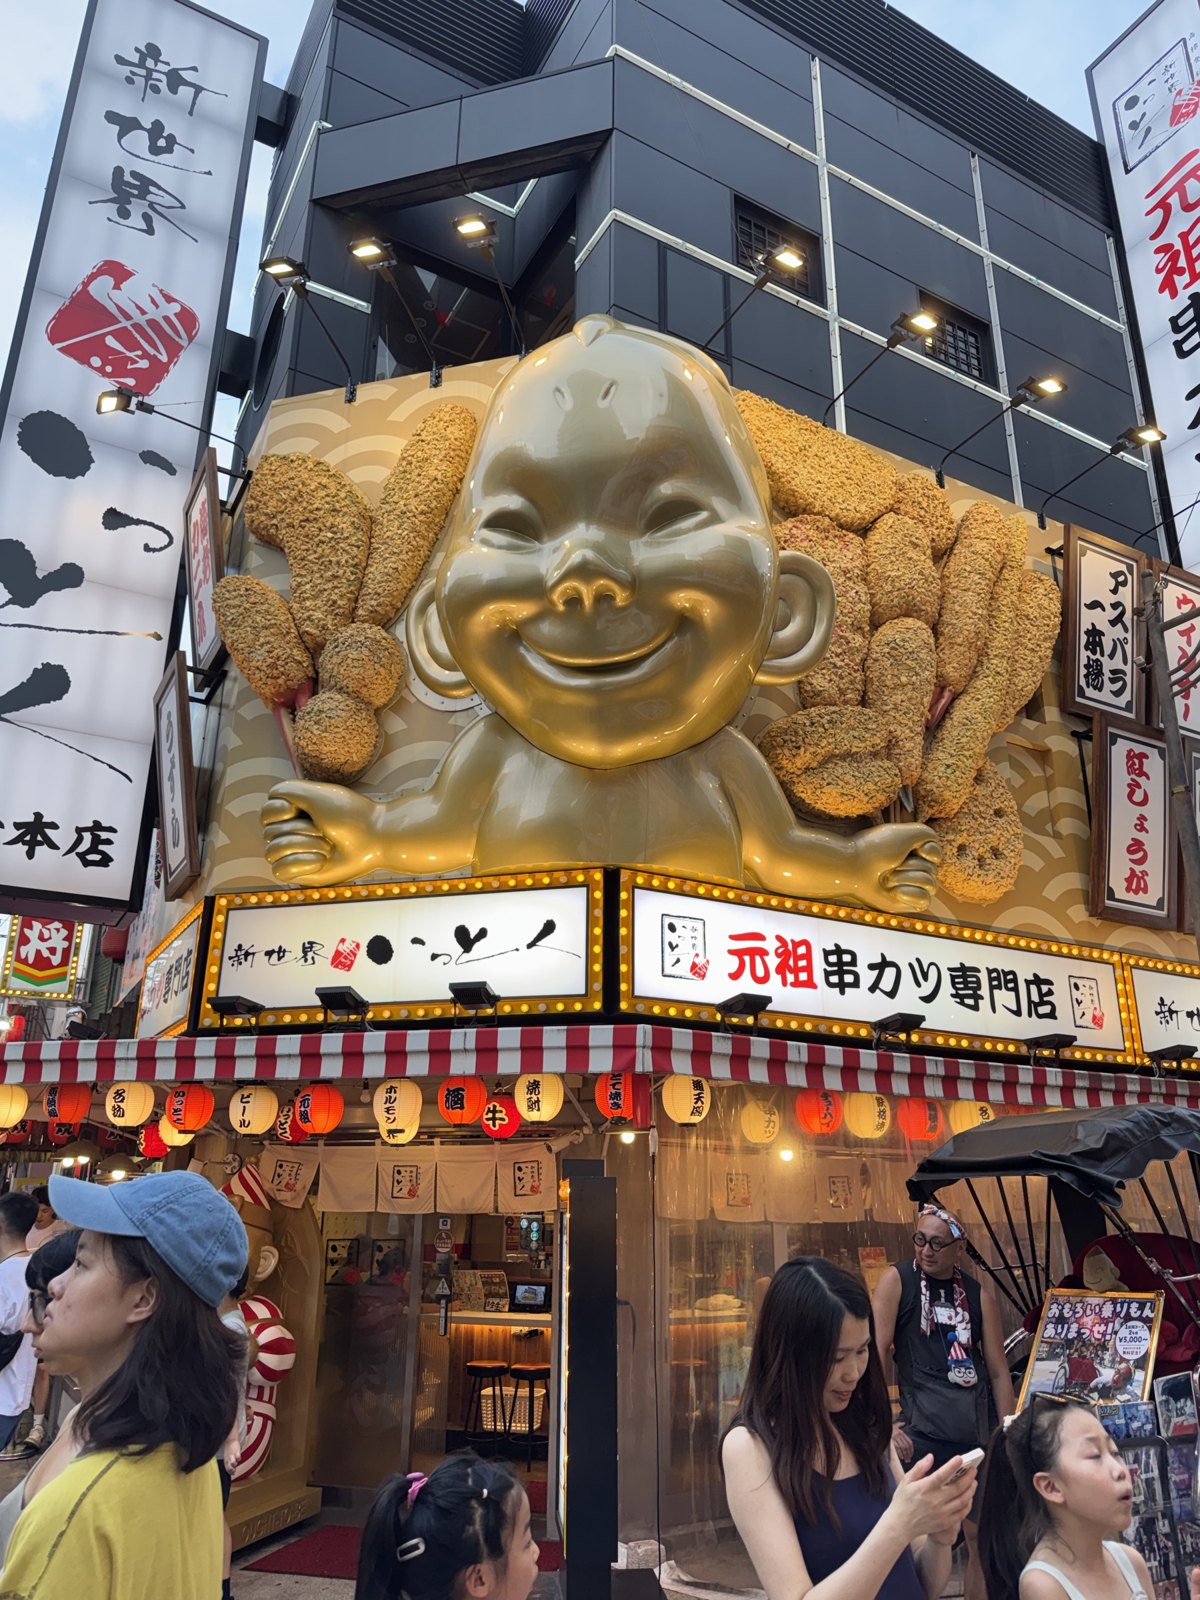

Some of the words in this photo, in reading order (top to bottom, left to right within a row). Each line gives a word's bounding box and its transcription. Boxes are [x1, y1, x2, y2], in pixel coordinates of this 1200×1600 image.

[89, 42, 228, 243] 新世界
[1083, 600, 1106, 693] 一本揚
[1107, 570, 1129, 698] アスパラ
[1124, 748, 1151, 895] 紅しょうが
[0, 811, 118, 868] 本店
[20, 920, 69, 966] 将
[228, 941, 328, 971] 新世界
[727, 932, 1058, 1020] 元祖串カツ専門店
[112, 1088, 126, 1118] 名物
[172, 1090, 185, 1125] いっとく
[239, 1093, 253, 1128] ビール
[298, 1093, 311, 1124] 元祖
[384, 1085, 398, 1124] ホルモン
[445, 1087, 466, 1110] 酒
[526, 1079, 541, 1112] 焼酎
[690, 1079, 705, 1117] 通天閣
[277, 1106, 293, 1140] いっとく
[484, 1104, 506, 1129] 牛
[979, 1106, 990, 1124] 名
[1047, 1301, 1155, 1319] おもろい乗りもん
[1043, 1322, 1113, 1341] ありまっせ!
